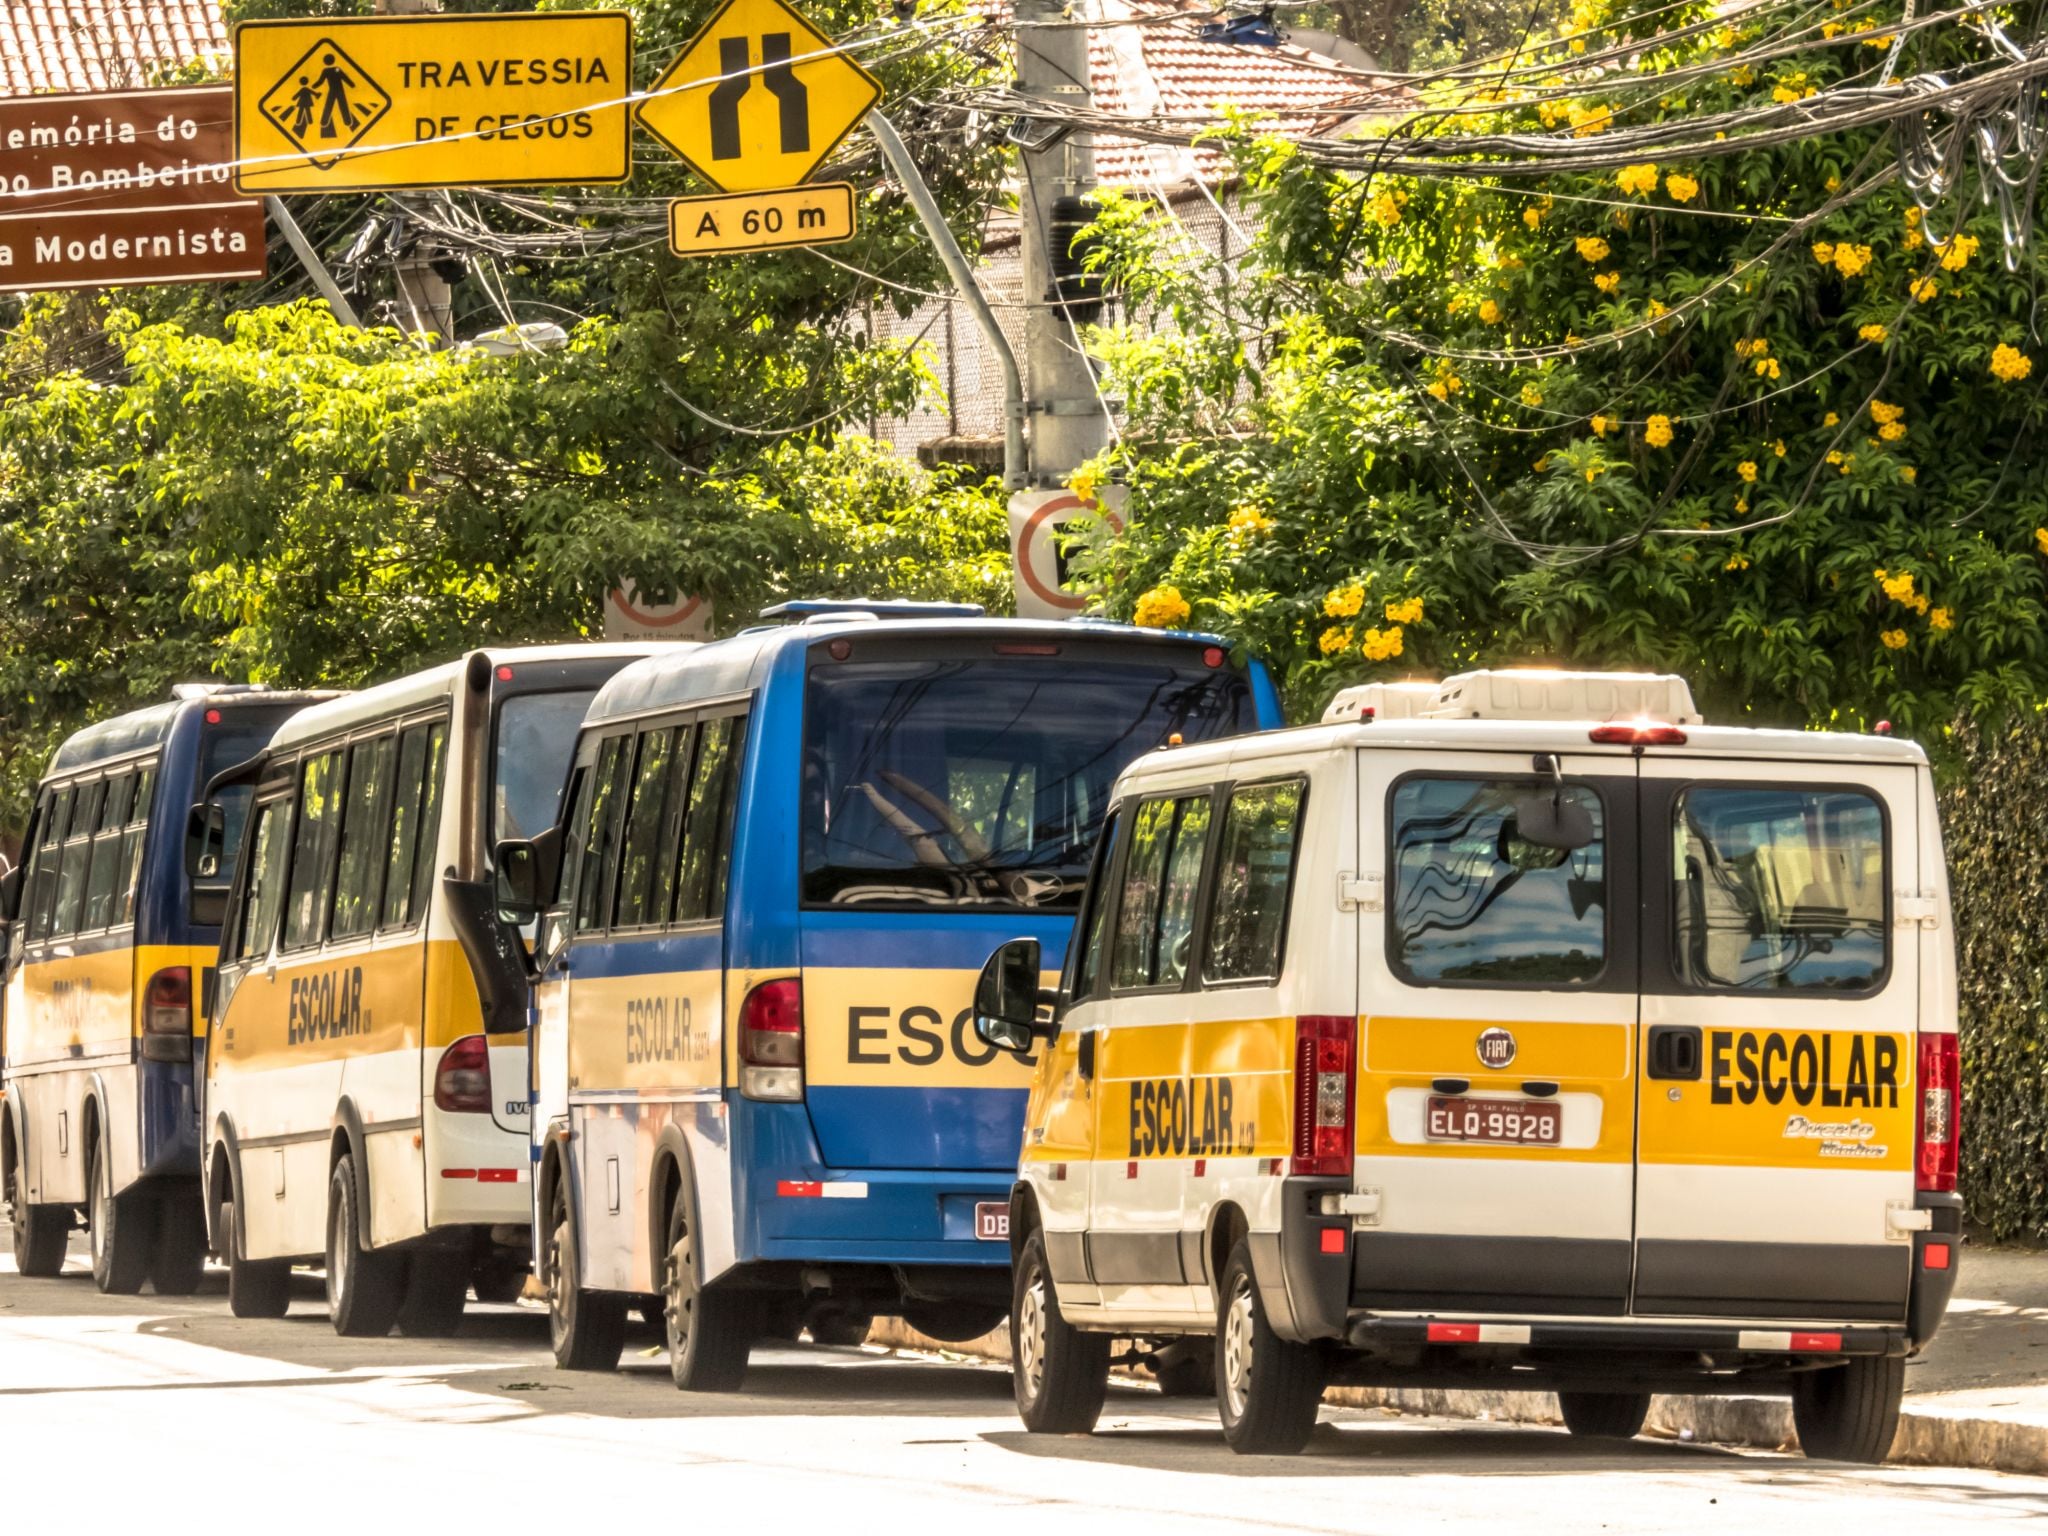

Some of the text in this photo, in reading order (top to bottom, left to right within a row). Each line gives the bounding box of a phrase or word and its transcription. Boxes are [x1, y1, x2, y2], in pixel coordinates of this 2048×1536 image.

[397, 57, 610, 88] TRAVESSIA
[0, 114, 198, 149] emória do
[415, 111, 593, 142] DE CEGOS
[52, 159, 229, 191] Bombeiro
[695, 207, 826, 238] A 60 m
[35, 228, 246, 264] Modernista
[623, 632, 640, 641] Por
[288, 966, 363, 1046] ESCOLAR
[627, 996, 692, 1064] ESCOLAR
[1486, 1040, 1509, 1058] FIAT
[1711, 1031, 1899, 1108] ESCOLAR
[1129, 1076, 1233, 1157] ESCOLAR
